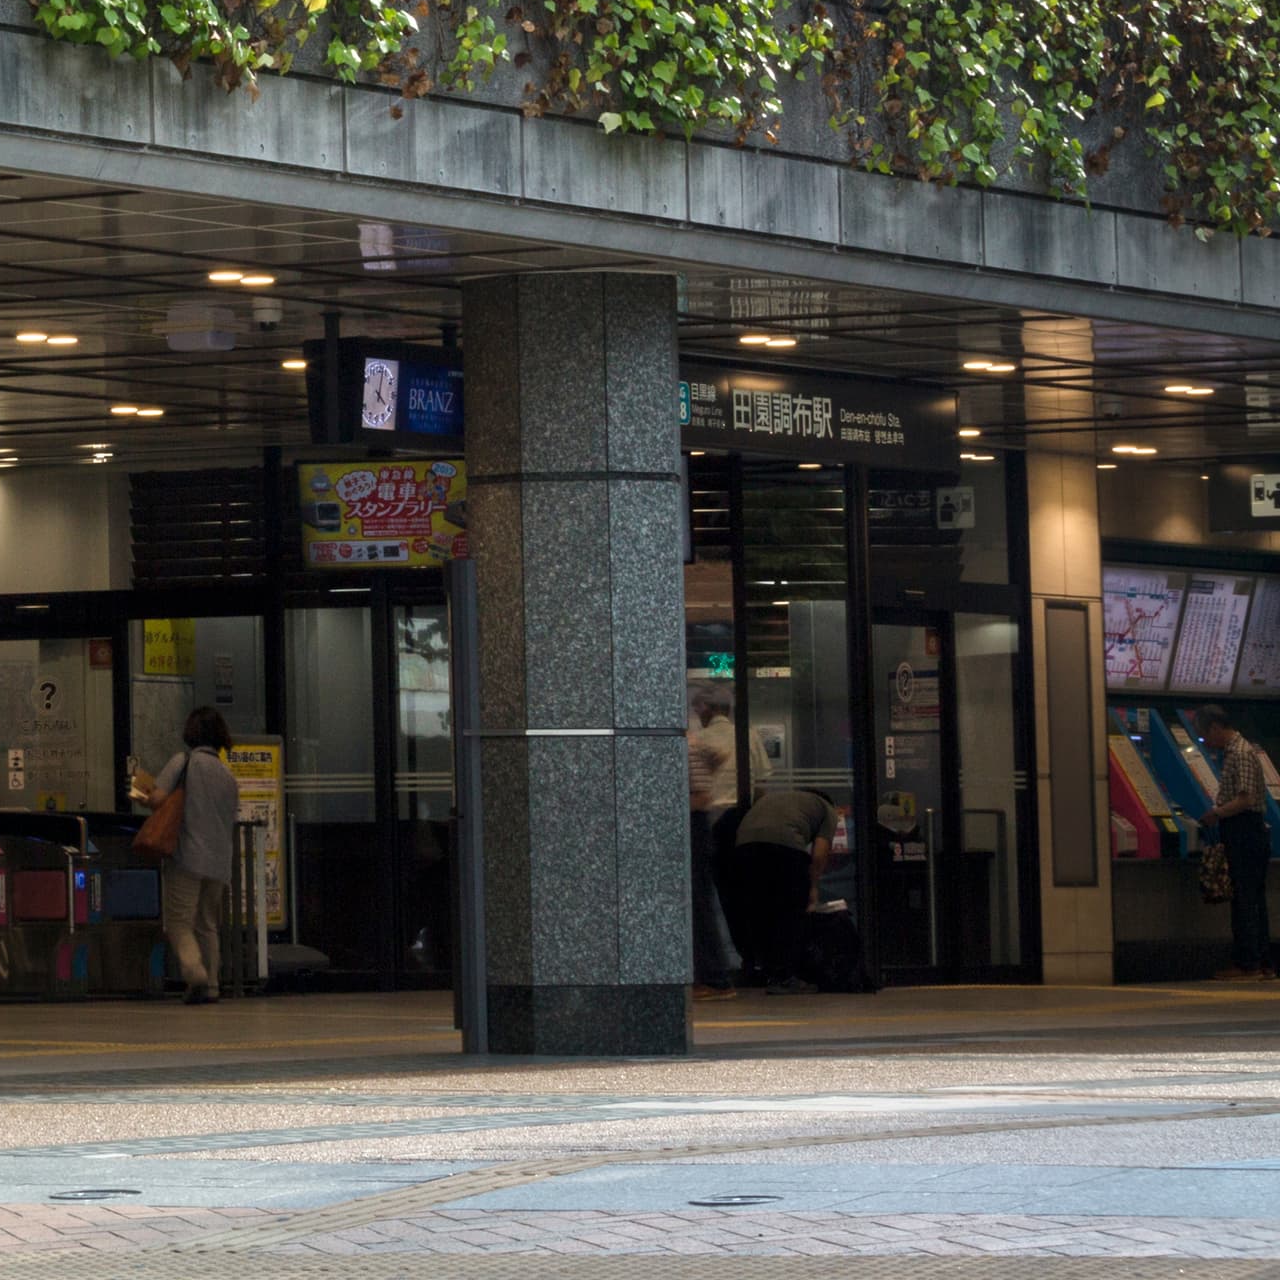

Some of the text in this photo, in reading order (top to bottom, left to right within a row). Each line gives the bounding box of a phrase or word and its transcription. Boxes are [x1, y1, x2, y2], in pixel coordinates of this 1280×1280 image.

[408, 387, 455, 413] BRANZ
[732, 389, 833, 439] 田園調布駅
[378, 482, 417, 501] 電車
[347, 500, 447, 518] スタンプラリー
